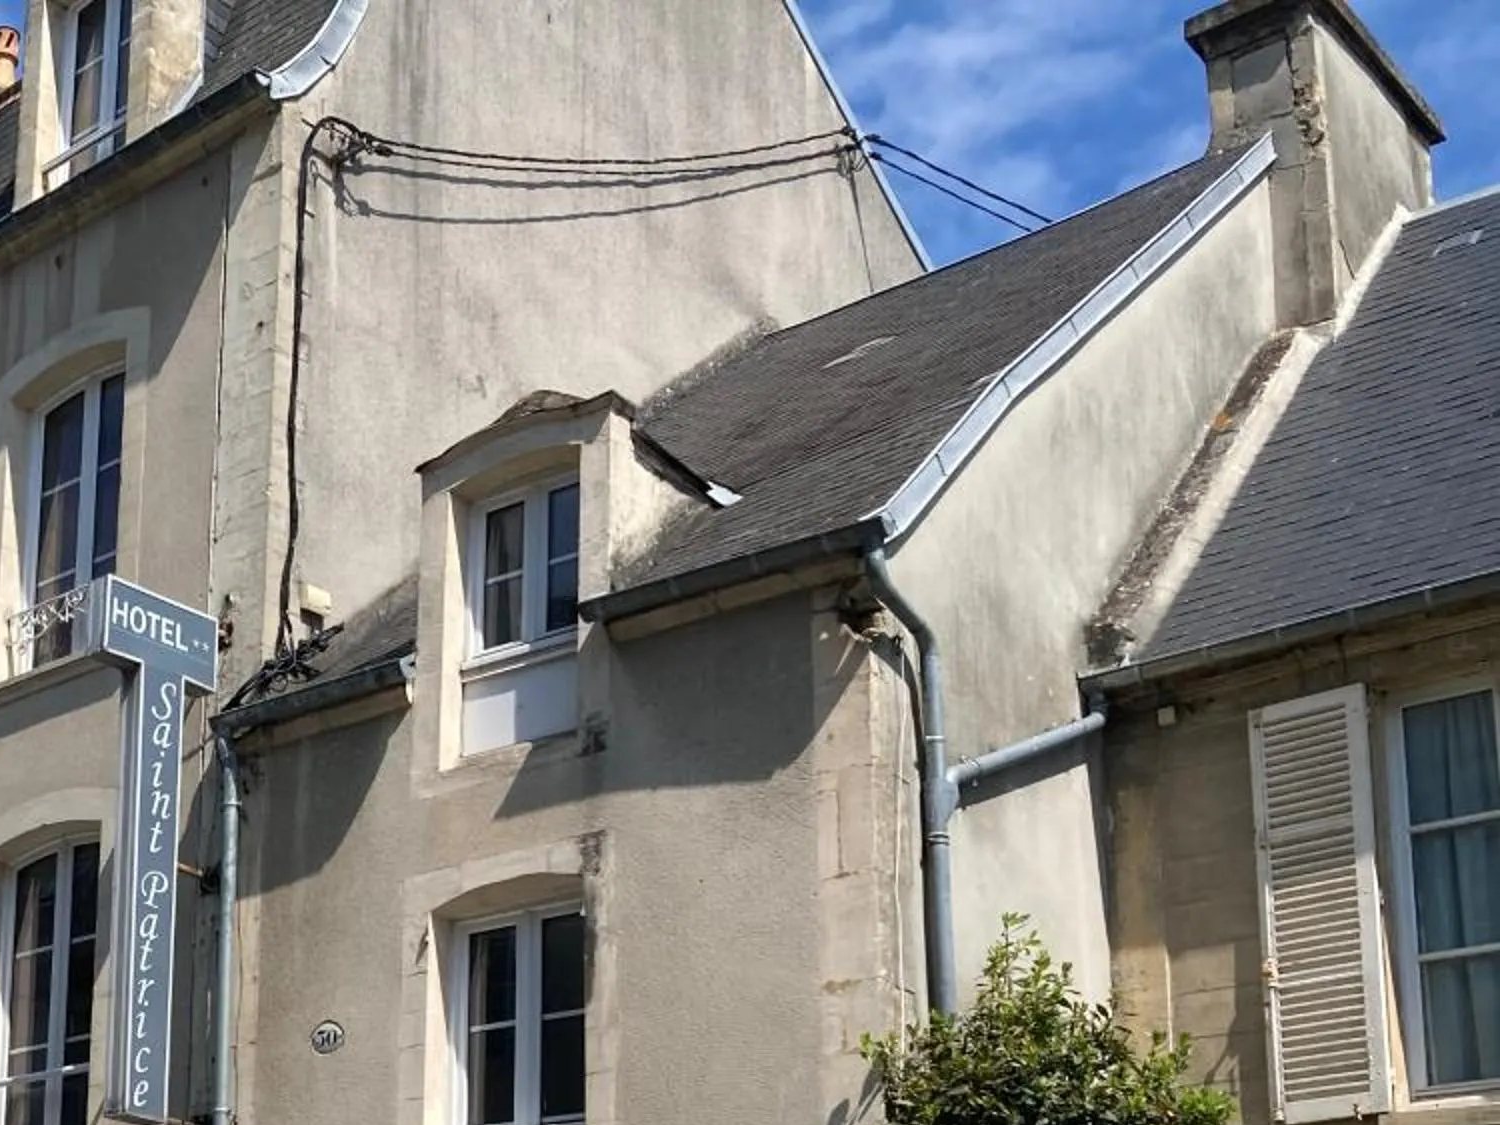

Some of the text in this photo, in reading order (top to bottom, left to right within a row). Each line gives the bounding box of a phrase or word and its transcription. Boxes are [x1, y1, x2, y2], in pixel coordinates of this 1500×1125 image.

[111, 596, 189, 653] HOTEL
[132, 681, 178, 1108] Saint Patrice
